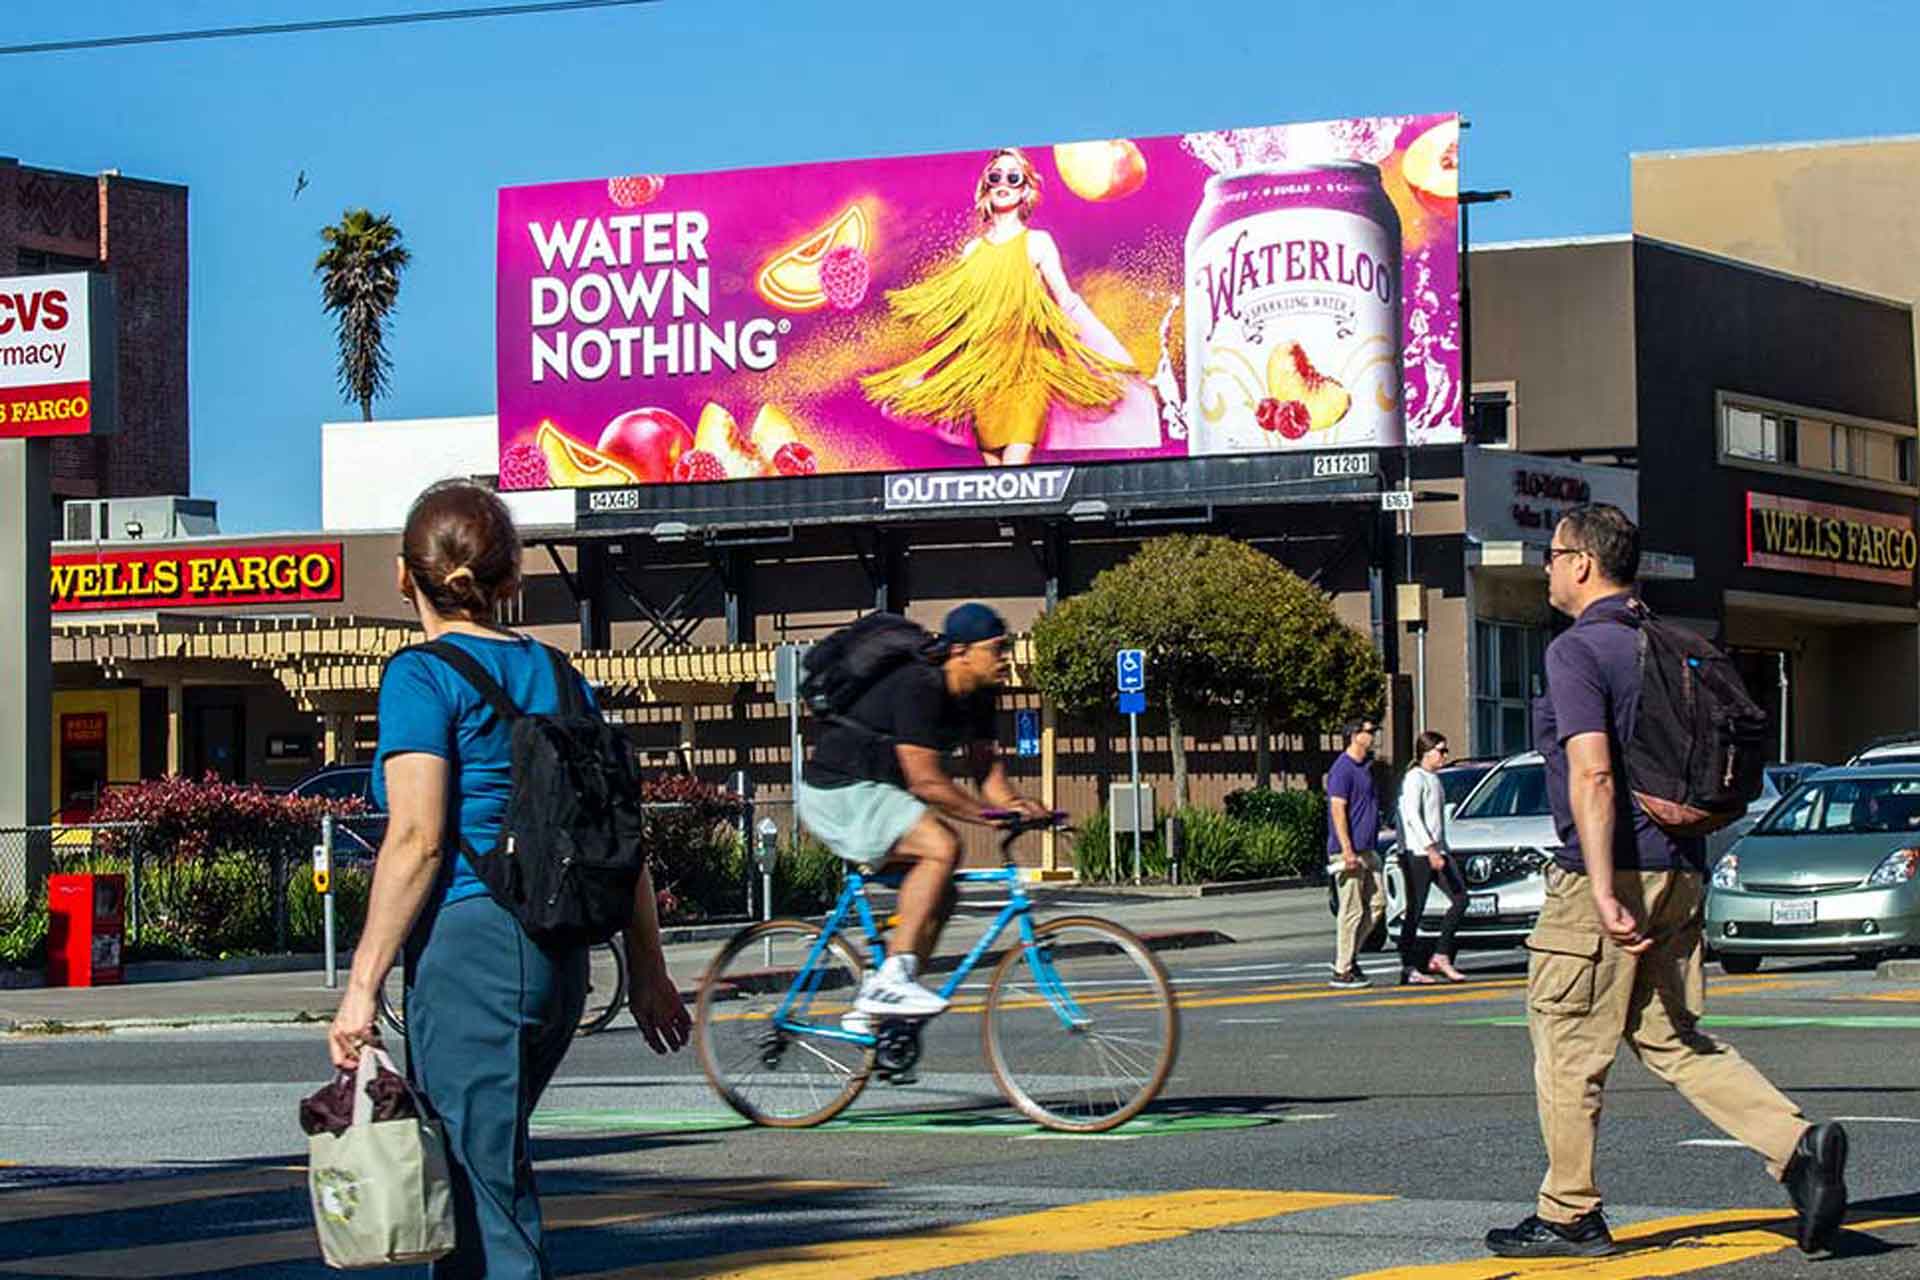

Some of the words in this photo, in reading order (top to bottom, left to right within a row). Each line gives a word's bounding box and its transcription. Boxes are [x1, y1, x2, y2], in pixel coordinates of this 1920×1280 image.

[528, 211, 709, 270] WATER
[531, 266, 710, 326] DOWN
[1196, 230, 1391, 342] WATERLOO
[11, 396, 89, 423] FARGO
[892, 471, 1064, 502] OUTFRONT
[1316, 455, 1368, 474] 211201
[1761, 509, 1842, 560] WELLS
[1846, 521, 1918, 570] FARGO
[50, 560, 179, 598] WELLS
[188, 553, 330, 592] FARGO
